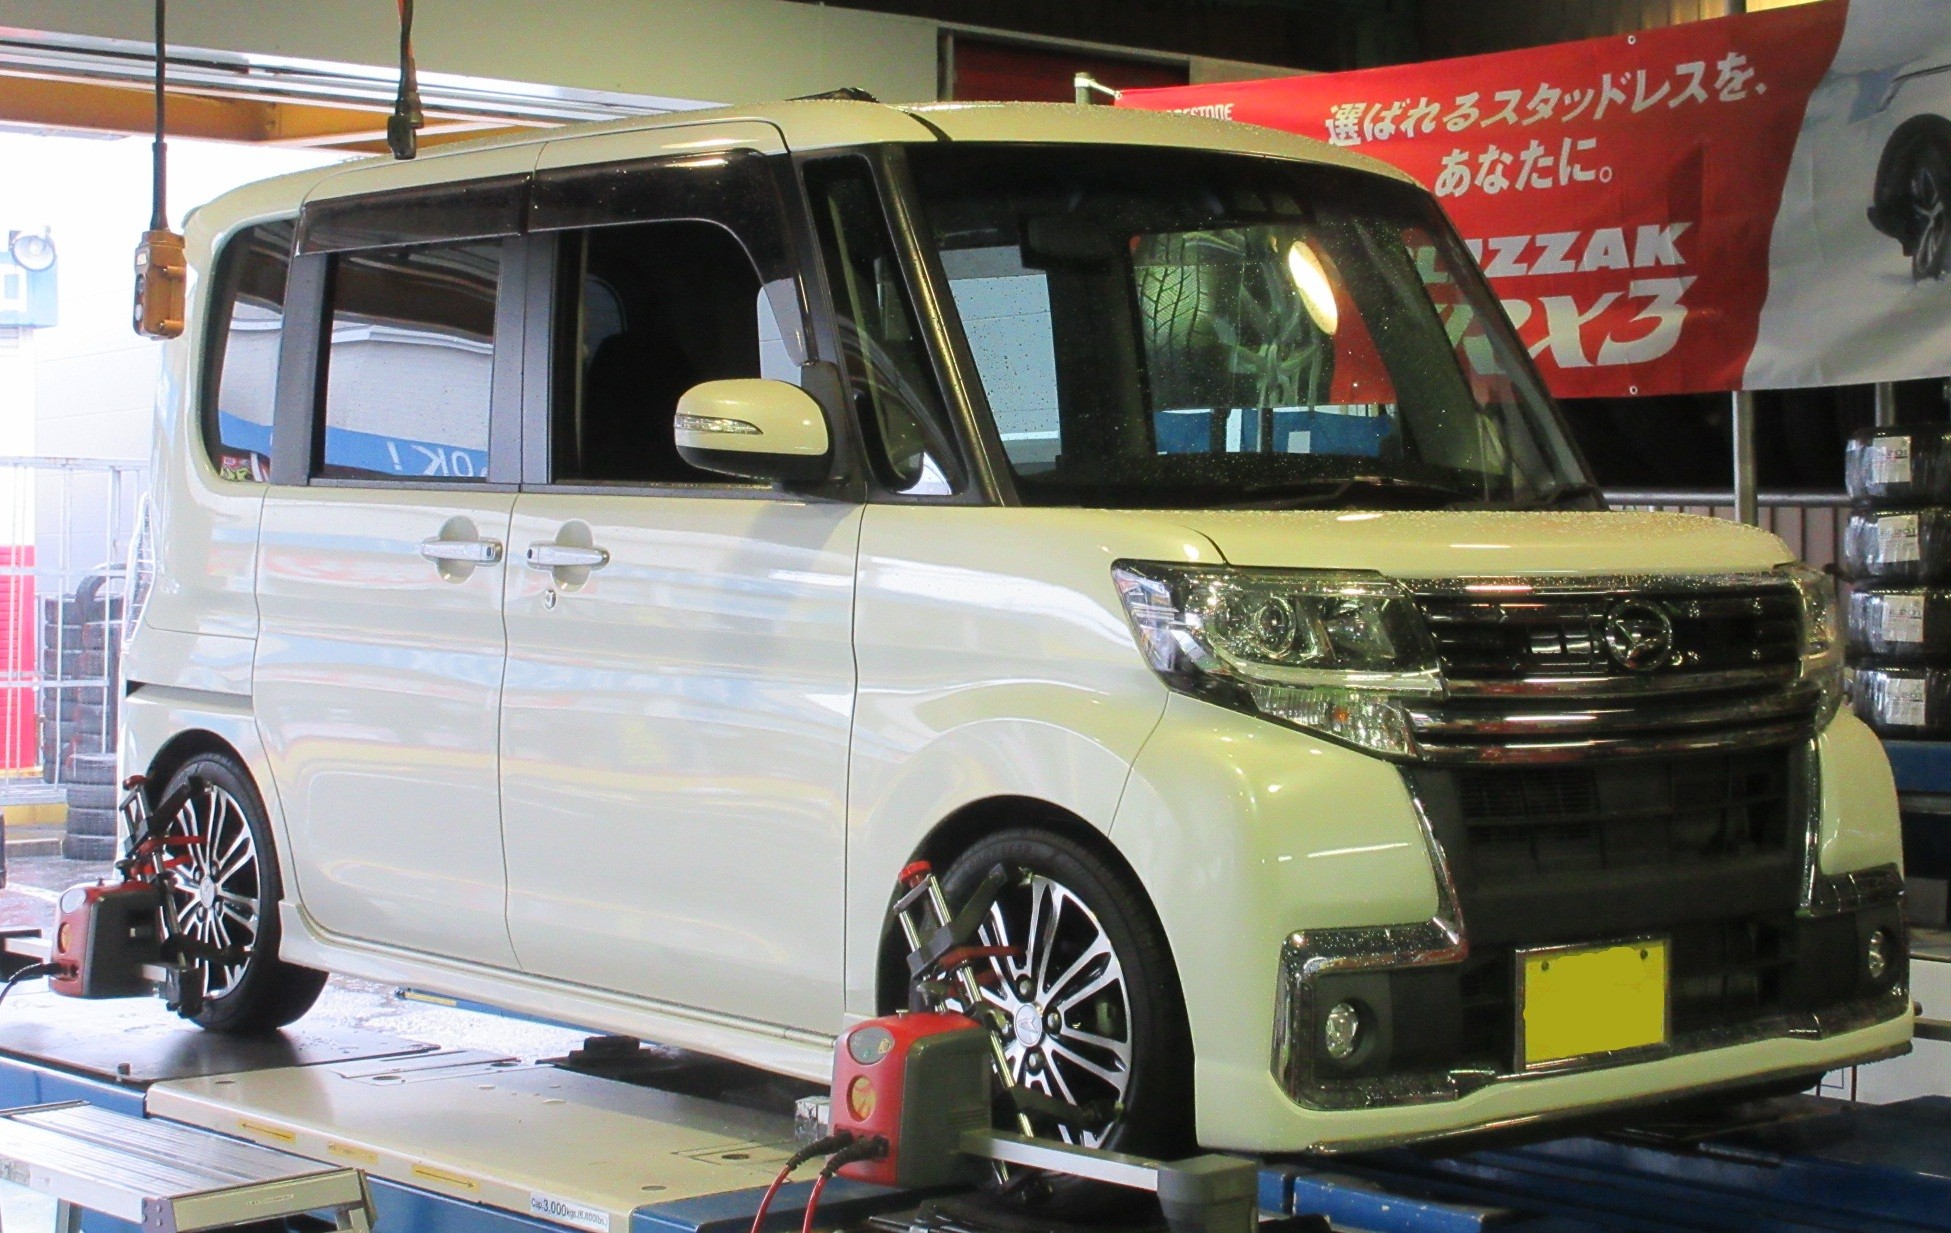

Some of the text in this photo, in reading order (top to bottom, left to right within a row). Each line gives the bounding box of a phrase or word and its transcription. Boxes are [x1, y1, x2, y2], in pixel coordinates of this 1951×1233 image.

[1325, 52, 1768, 147] 選ばれるスタッドレスを、
[1434, 137, 1613, 198] あなたに。
